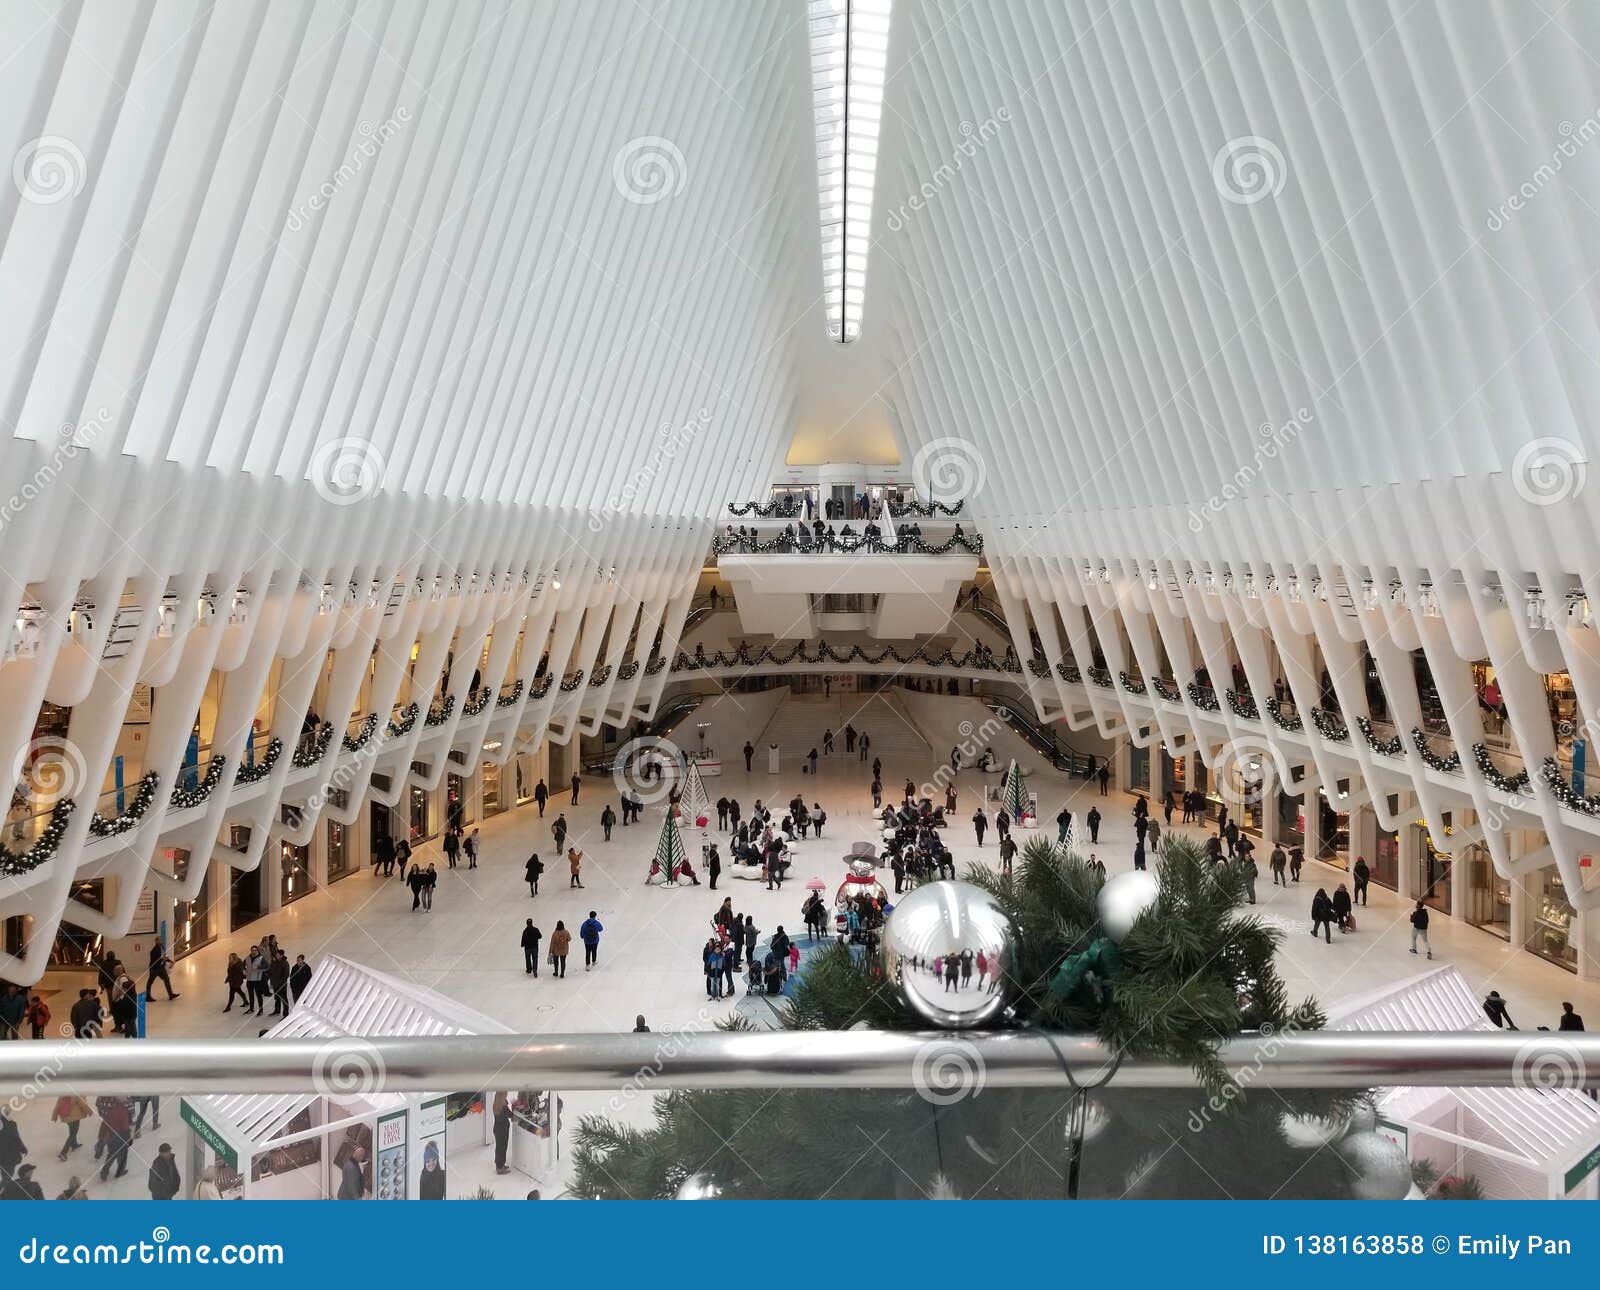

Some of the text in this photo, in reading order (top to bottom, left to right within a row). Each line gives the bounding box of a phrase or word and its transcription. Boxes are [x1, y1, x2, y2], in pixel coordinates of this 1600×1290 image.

[383, 1120, 401, 1131] MADE
[383, 1127, 401, 1138] FROM
[383, 1133, 401, 1146] COINS
